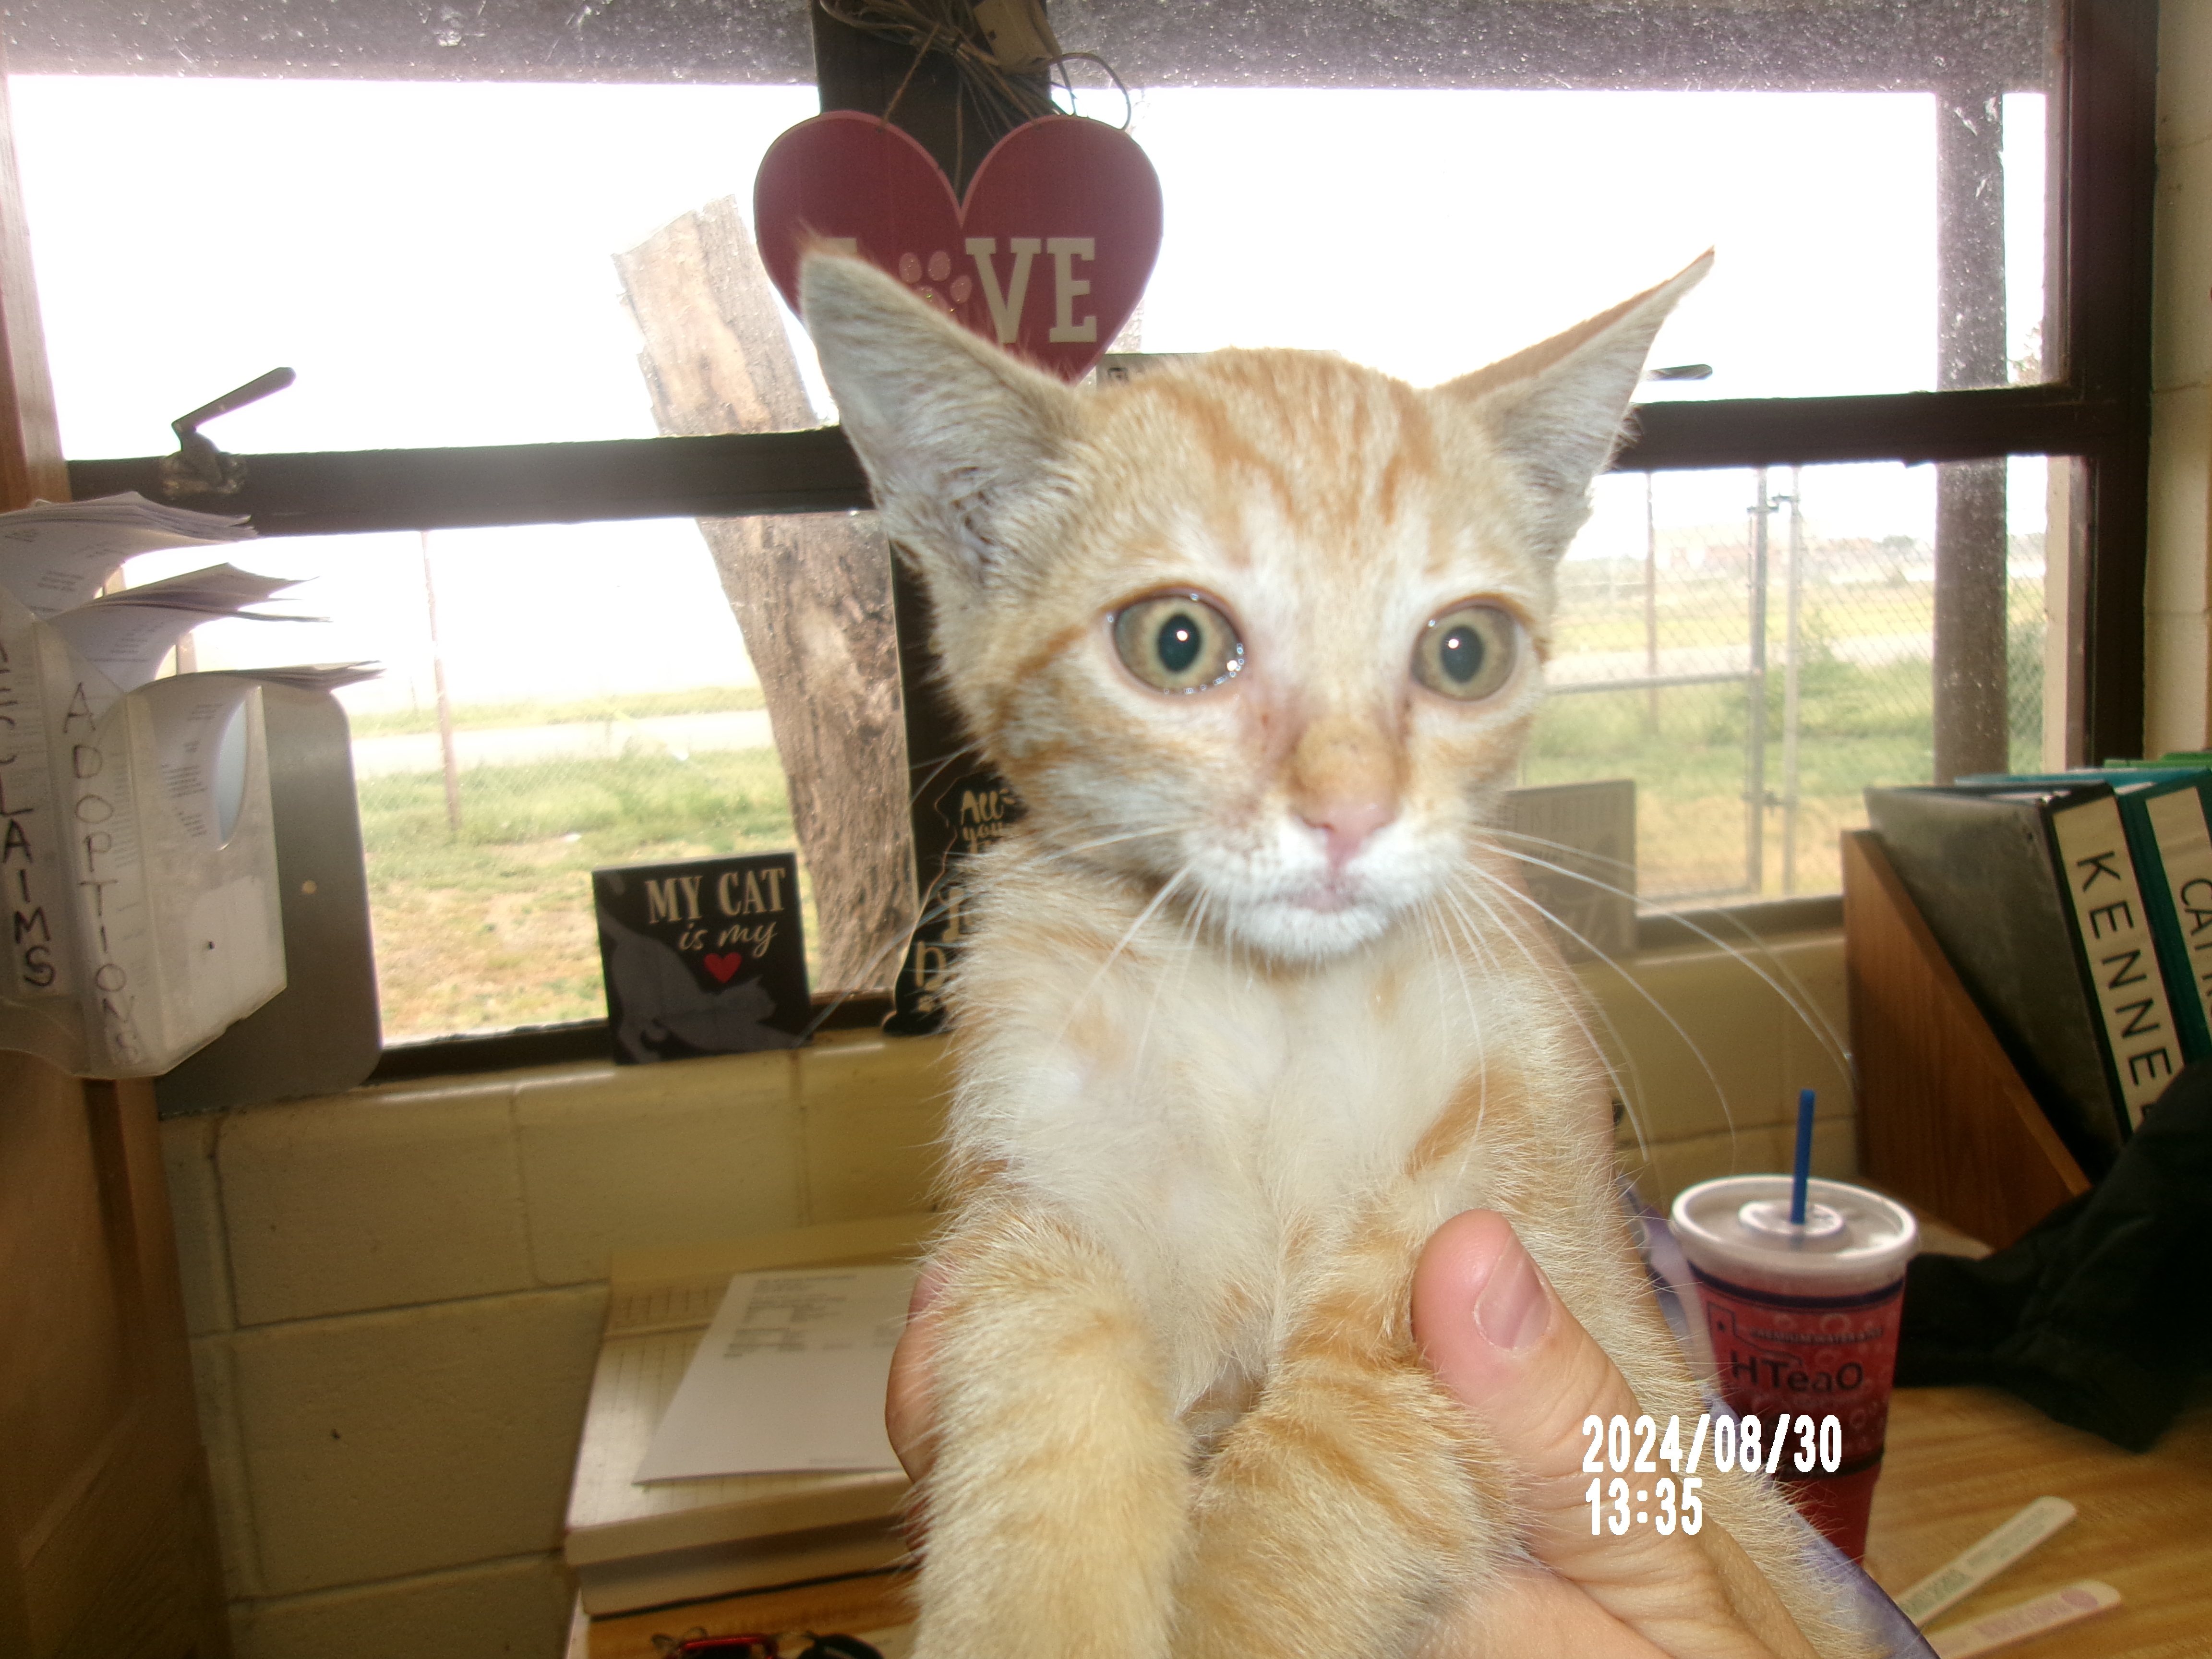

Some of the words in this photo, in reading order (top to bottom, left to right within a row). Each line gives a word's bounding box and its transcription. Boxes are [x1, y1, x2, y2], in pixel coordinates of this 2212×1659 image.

[960, 790, 1005, 825] All
[645, 876, 703, 924] MY
[718, 867, 786, 916] CAT
[678, 923, 708, 950] is
[717, 922, 778, 958] my
[2077, 851, 2173, 1118] KENNE
[1730, 1350, 1864, 1393] HTeaO
